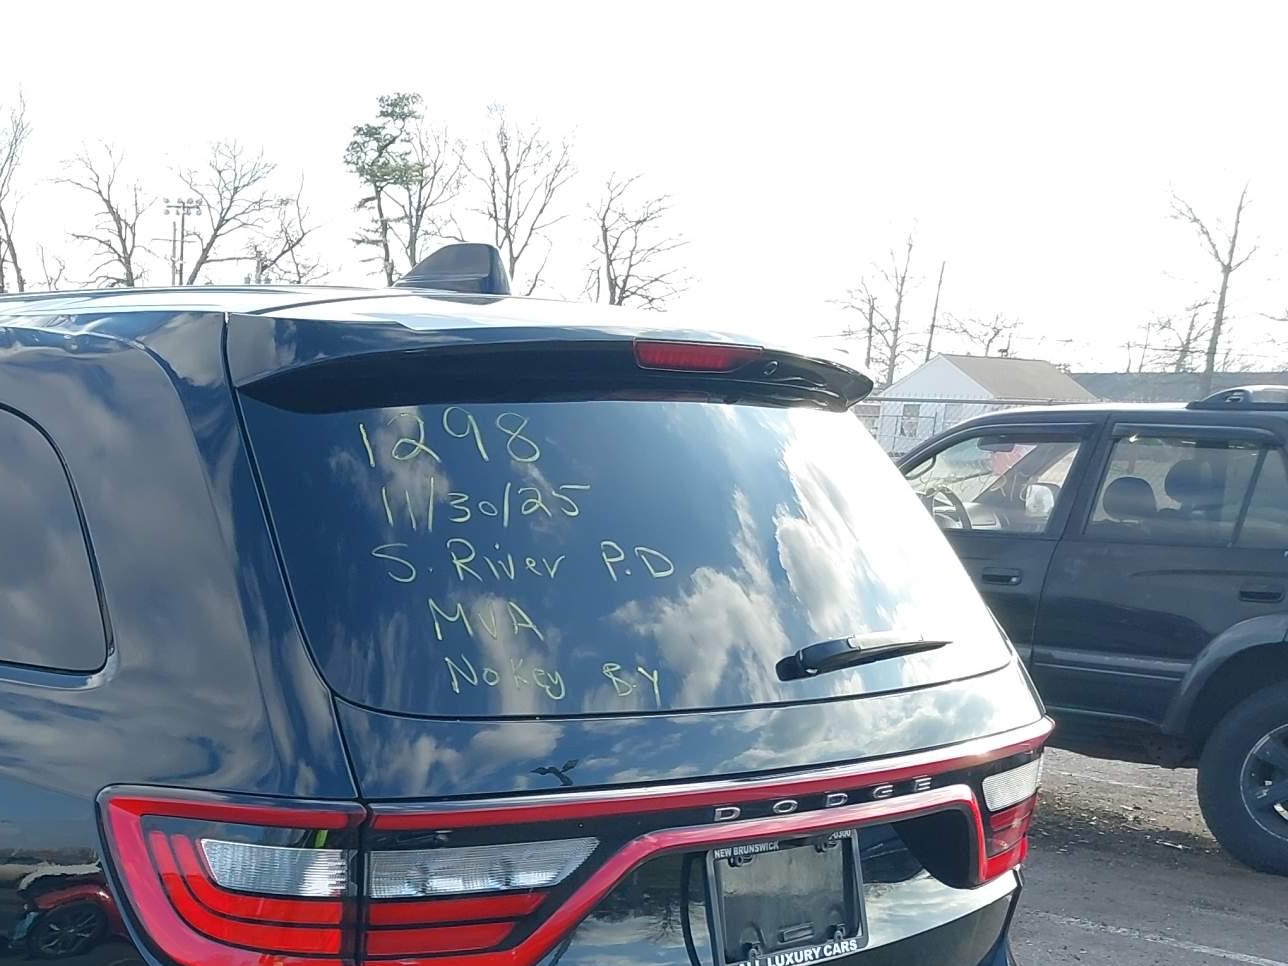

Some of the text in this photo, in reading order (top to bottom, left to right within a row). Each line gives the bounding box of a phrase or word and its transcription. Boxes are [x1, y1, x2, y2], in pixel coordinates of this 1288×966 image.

[358, 405, 541, 469] 1298
[381, 475, 592, 533] 11/30/25
[371, 542, 434, 583] S.
[446, 537, 566, 583] River
[427, 599, 545, 642] MVA
[713, 775, 933, 823] DODGE
[714, 848, 732, 859] NEW
[732, 840, 780, 856] BRUNSWICK
[823, 938, 858, 957] CARS
